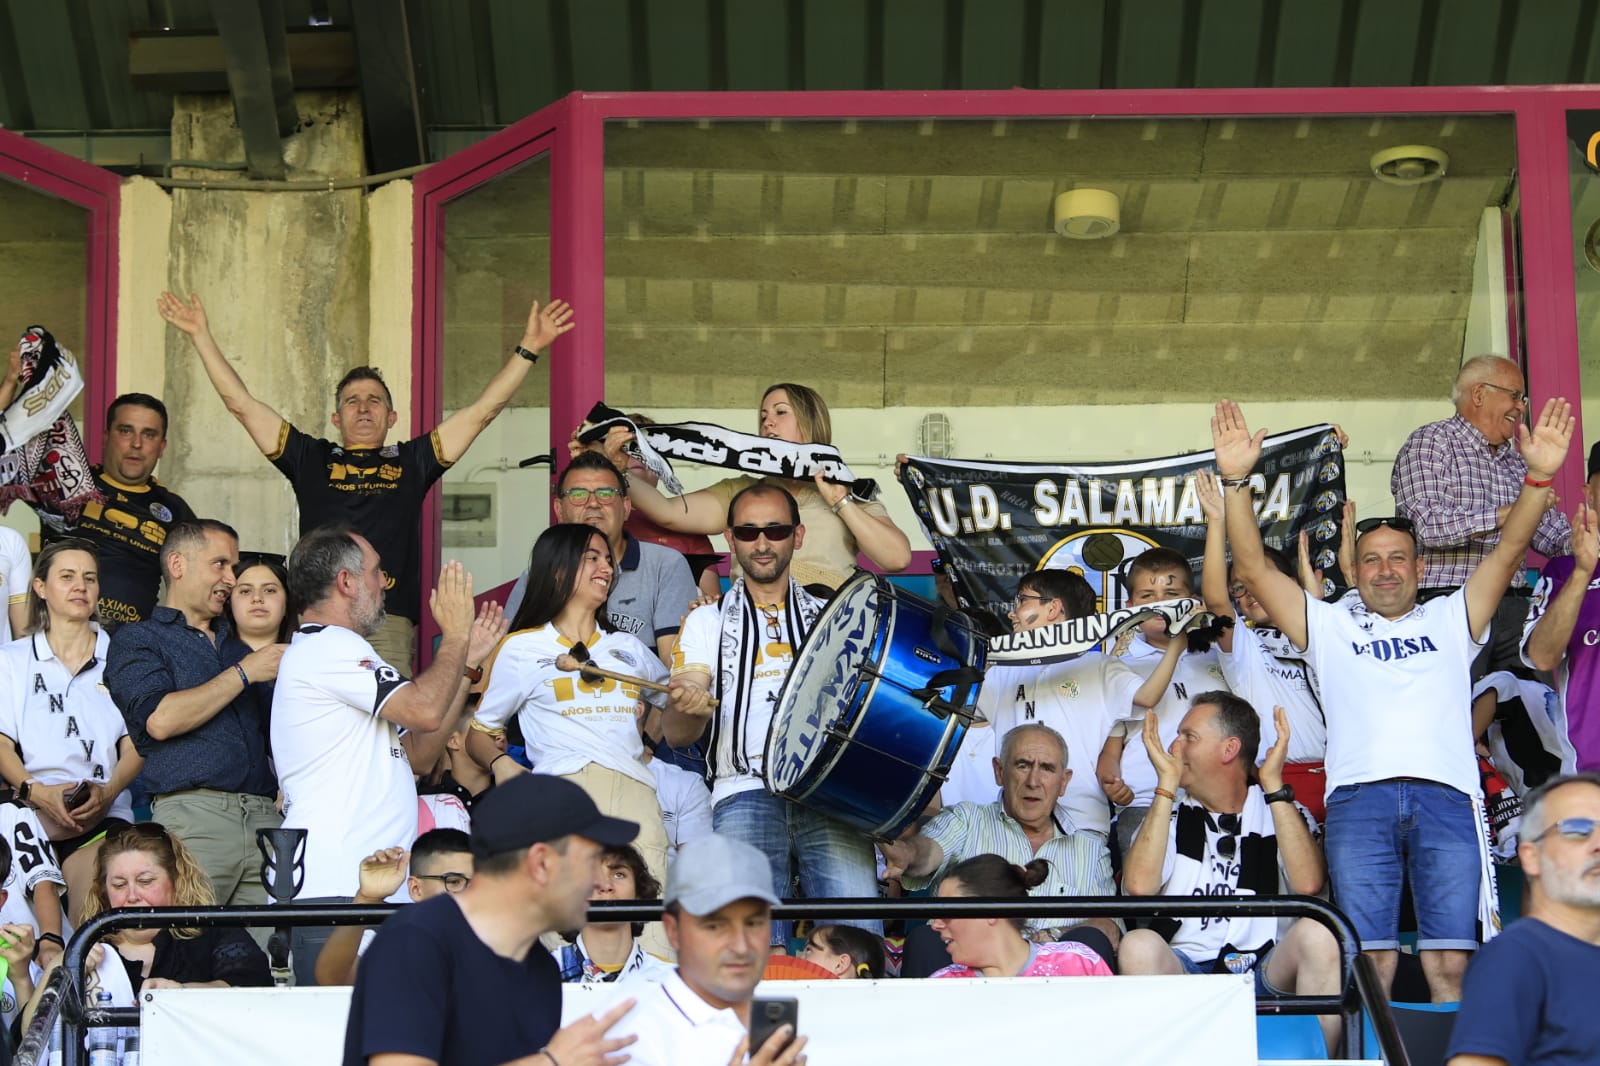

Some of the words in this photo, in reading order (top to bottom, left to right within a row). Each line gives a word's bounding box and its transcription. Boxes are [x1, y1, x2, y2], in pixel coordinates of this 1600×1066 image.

[927, 483, 1012, 537] U.D.
[1033, 472, 1291, 527] SALAMACA
[561, 706, 593, 717] AÑOS
[595, 706, 611, 714] DE
